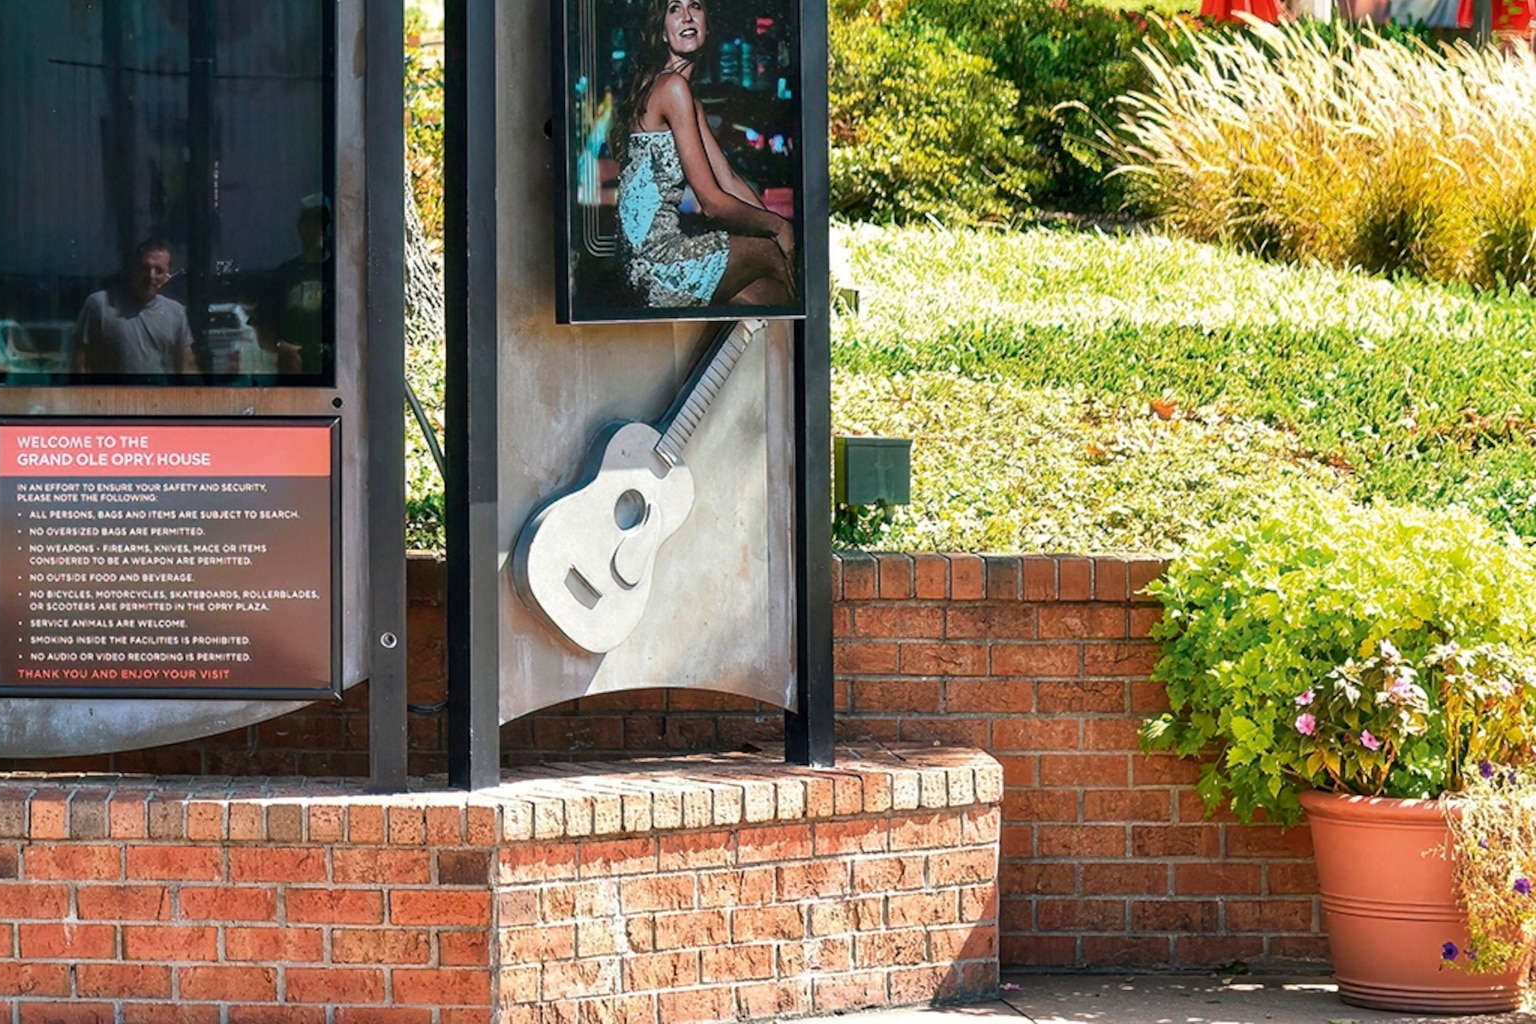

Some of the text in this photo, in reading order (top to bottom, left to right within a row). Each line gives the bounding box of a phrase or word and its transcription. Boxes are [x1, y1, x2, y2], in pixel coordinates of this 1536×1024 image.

[16, 434, 148, 451] WELCOME TO THE
[16, 452, 73, 468] GRAND
[75, 452, 108, 466] OLE
[156, 451, 211, 468] HOUSE
[17, 483, 27, 491] IN
[28, 483, 43, 491] AN
[43, 482, 80, 492] EFFORT
[82, 482, 95, 492] TO
[96, 482, 133, 492] ENSURE
[134, 482, 161, 492] YOUR
[162, 482, 198, 492] SAFETY
[198, 482, 220, 492] AND
[16, 492, 51, 502] PLEASE
[52, 493, 78, 502] NOTE
[79, 492, 98, 502] THE
[28, 510, 47, 519] ALL
[97, 509, 123, 519] BAGS
[124, 509, 146, 519] AND
[147, 509, 176, 519] ITEMS
[177, 509, 197, 519] ARE
[199, 509, 241, 519] SUBJECT
[243, 509, 257, 519] TO
[28, 526, 44, 536] NO
[45, 526, 100, 536] OVERSIZED
[100, 526, 127, 536] BAGS
[128, 526, 148, 536] ARE
[28, 543, 44, 553] NO
[45, 543, 94, 553] WEAPONS
[192, 543, 220, 553] MACE
[221, 543, 237, 553] OR
[238, 543, 267, 553] ITEMS
[28, 555, 90, 565] CONSIDERED
[91, 555, 105, 566] TO
[106, 555, 119, 565] BE
[121, 556, 129, 565] A
[130, 555, 174, 566] WEAPON
[175, 555, 195, 565] ARE
[29, 572, 44, 582] NO
[45, 572, 87, 582] OUTSIDE
[88, 572, 117, 582] FOOD
[118, 572, 140, 582] AND
[29, 589, 44, 599] NO
[28, 601, 44, 611] OR
[45, 601, 96, 611] SCOOTERS
[97, 601, 117, 611] ARE
[119, 601, 173, 611] PERMITTED
[173, 602, 185, 611] IN
[186, 602, 205, 611] THE
[206, 601, 233, 611] OPRY
[29, 618, 68, 628] SERVICE
[71, 618, 114, 628] ANIMALS
[115, 618, 135, 628] ARE
[30, 635, 74, 645] SMOKING
[75, 635, 106, 645] INSIDE
[108, 635, 127, 645] THE
[129, 635, 179, 645] FACILITIES
[180, 635, 190, 645] IS
[30, 651, 45, 661] NO
[46, 651, 78, 661] AUDIO
[78, 651, 94, 662] OR
[95, 651, 126, 662] VIDEO
[127, 651, 184, 662] RECORDING
[184, 651, 194, 662] IS
[17, 668, 229, 680] THANK YOU AND ENJOY YOUR VISIT
